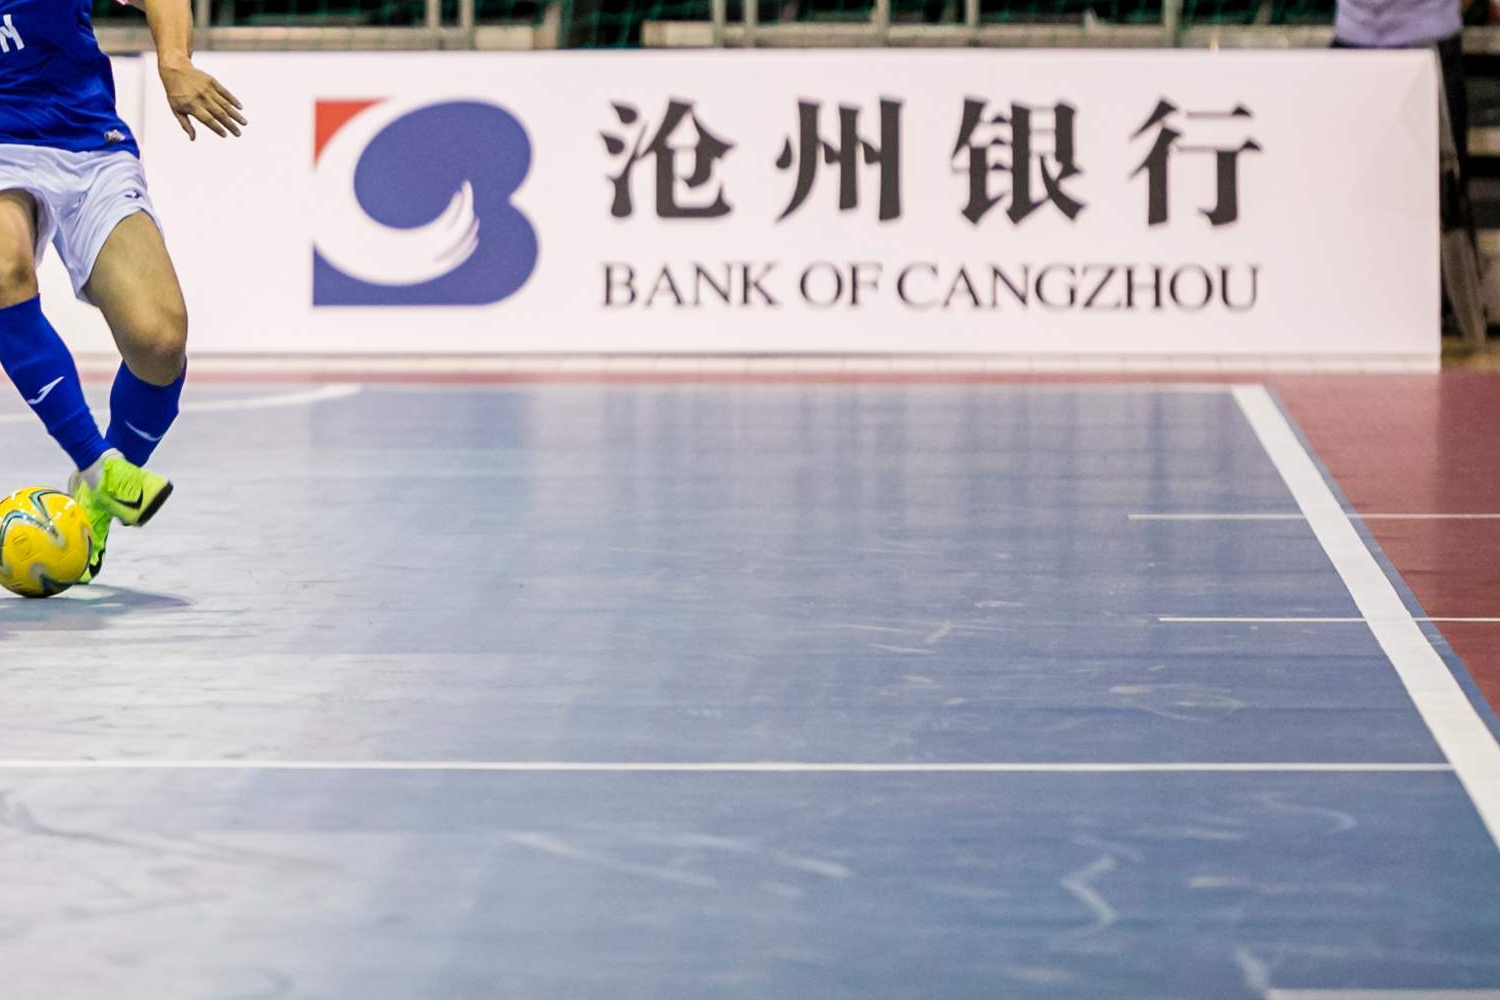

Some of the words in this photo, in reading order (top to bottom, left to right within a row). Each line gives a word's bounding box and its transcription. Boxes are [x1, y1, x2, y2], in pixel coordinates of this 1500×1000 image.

[599, 96, 1263, 229] 沧州银行
[600, 262, 781, 309] BANK
[798, 262, 886, 309] OF
[896, 261, 1263, 311] CANGZHOU
